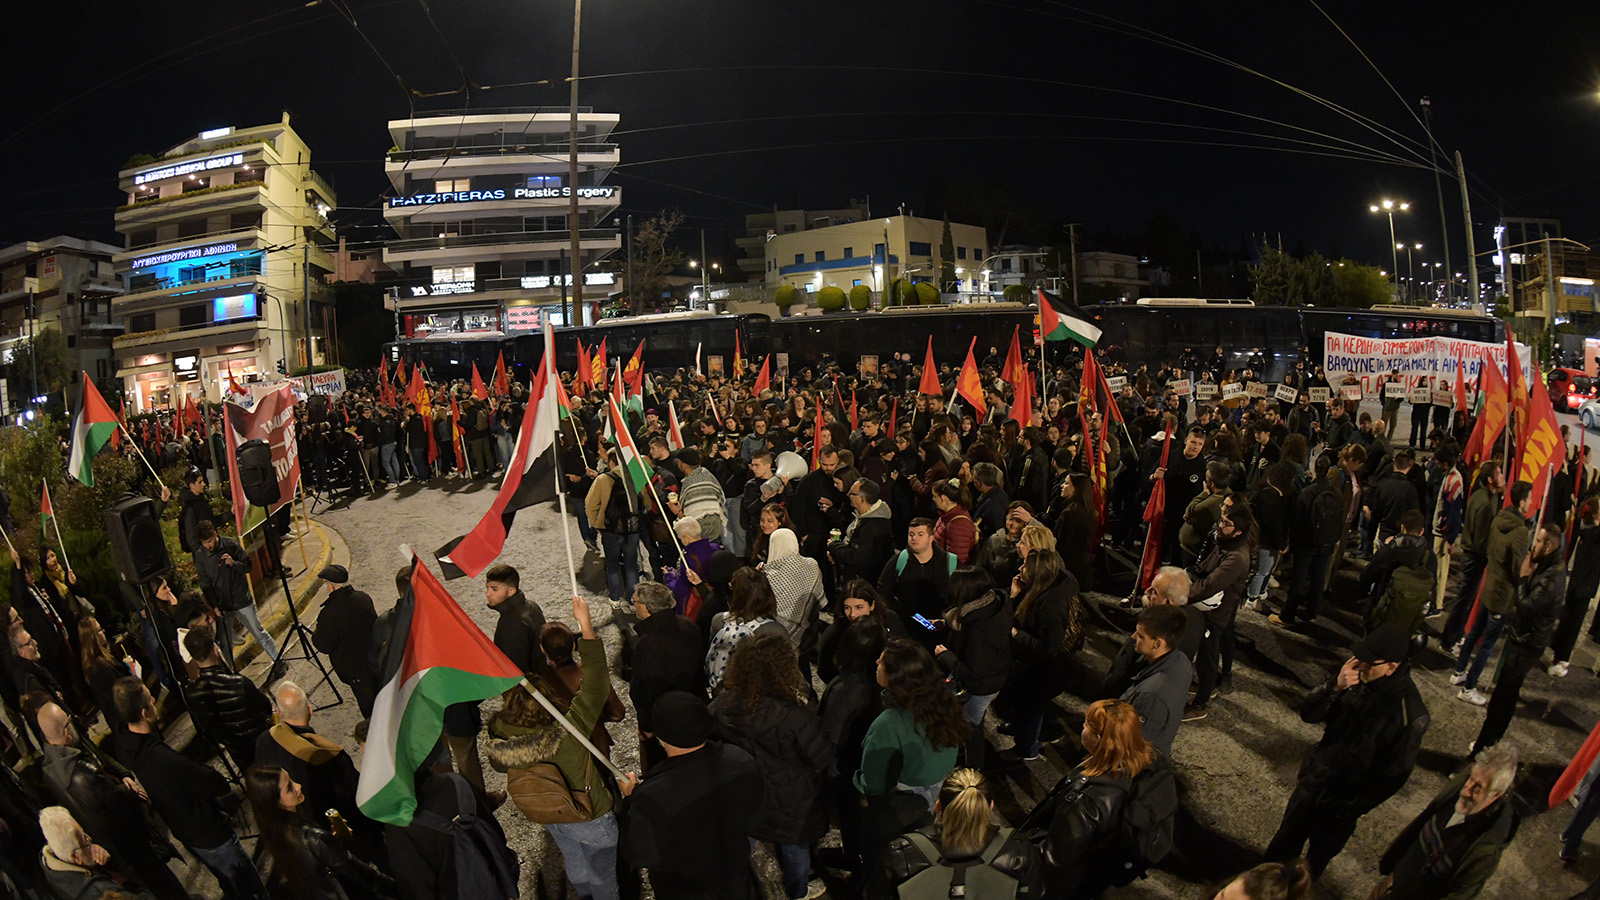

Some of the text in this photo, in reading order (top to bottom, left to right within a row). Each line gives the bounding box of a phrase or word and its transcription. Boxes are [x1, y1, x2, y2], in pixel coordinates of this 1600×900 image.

[206, 156, 233, 170] GROUP
[514, 187, 560, 198] Plastic
[1343, 336, 1373, 355] ΚΕΡΔΗ
[1382, 339, 1435, 355] ΣΥΜΦΕΡΟΝΤΑ
[1327, 354, 1376, 373] ΒΑΦΟΥΝΕ
[1376, 358, 1385, 372] ΤΑ
[1386, 358, 1410, 372] ΧΕΡΙΑ
[1411, 357, 1427, 371] ΜΑΣ
[1427, 358, 1439, 372] ΜΕ
